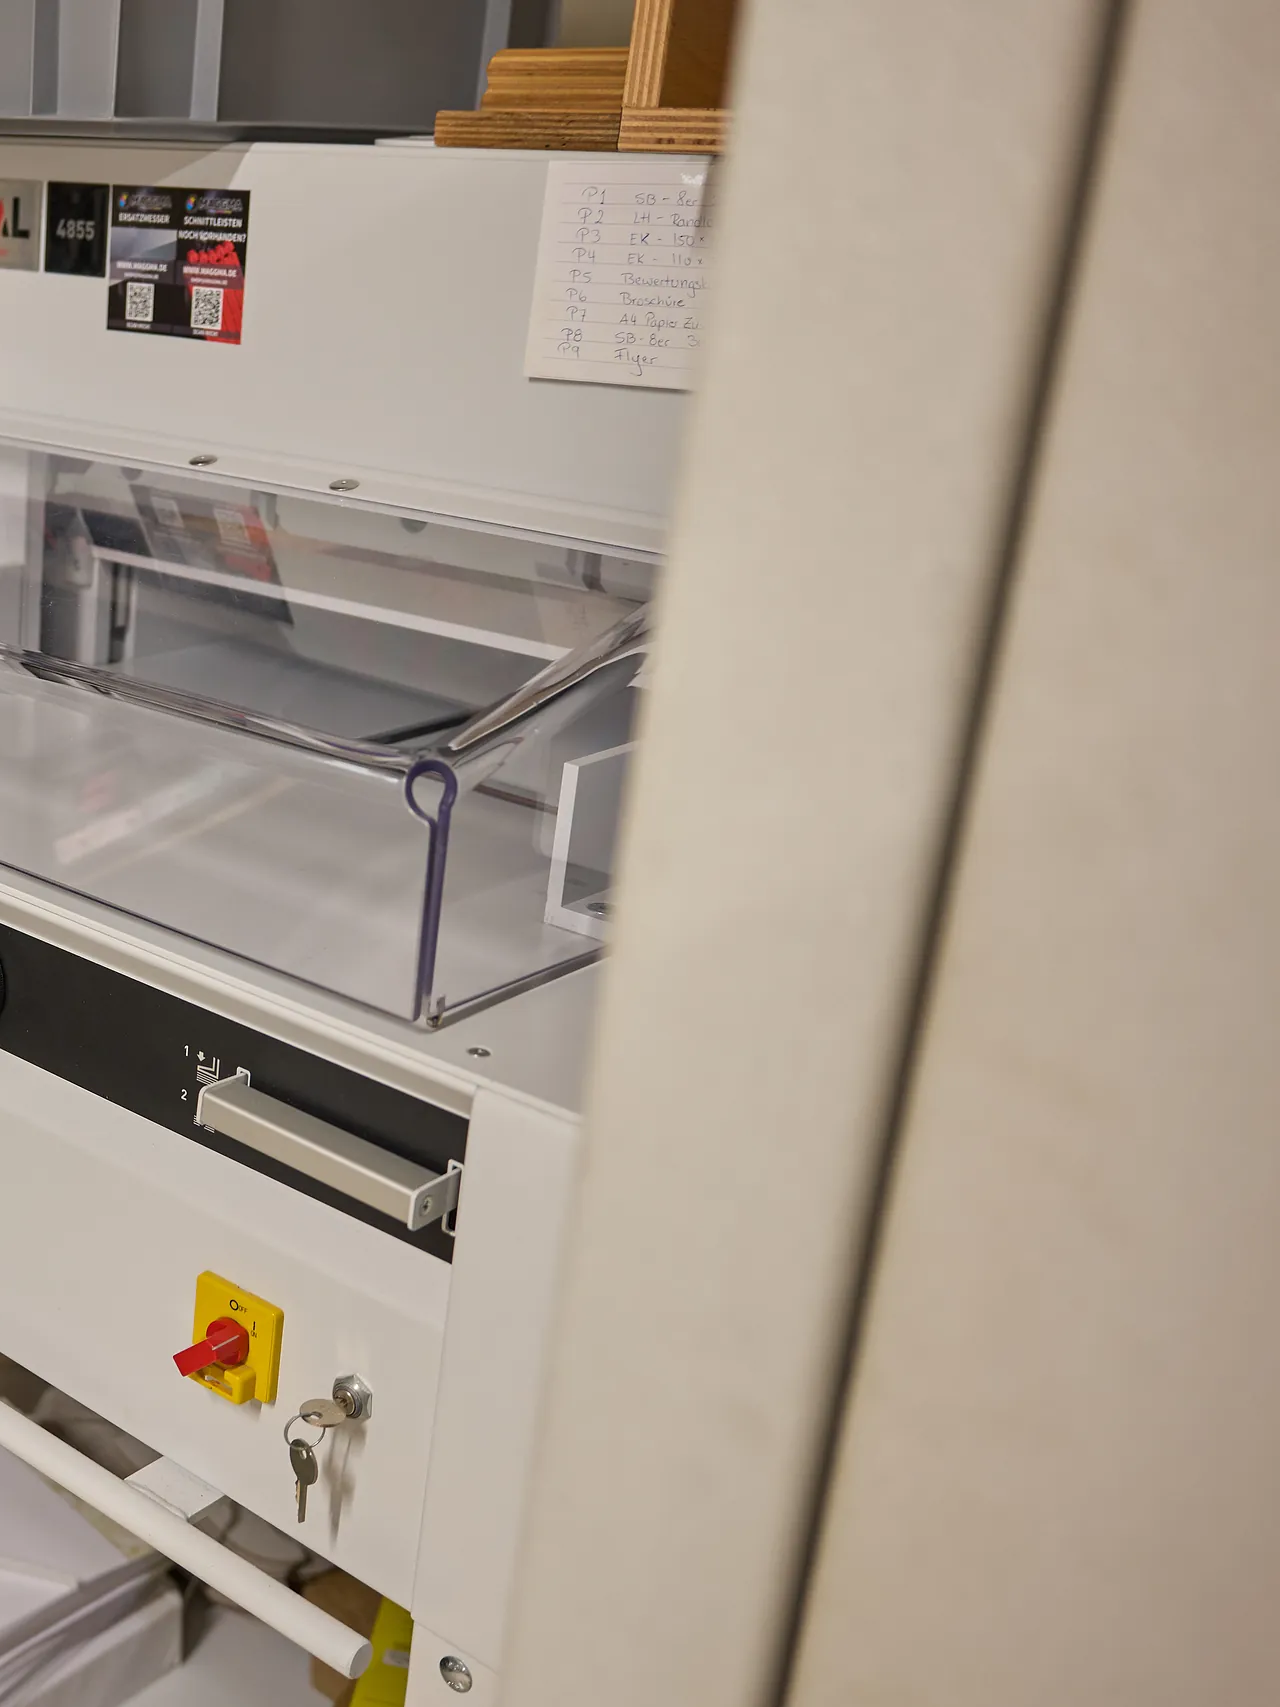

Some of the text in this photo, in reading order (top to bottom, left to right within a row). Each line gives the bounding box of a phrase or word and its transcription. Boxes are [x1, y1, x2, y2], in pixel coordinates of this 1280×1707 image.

[581, 186, 606, 205] P1
[183, 216, 243, 228] SCHNITTLEISTEN
[577, 207, 605, 225] P2
[55, 219, 96, 240] 4855
[576, 227, 601, 244] P3
[630, 233, 650, 246] EK
[572, 247, 595, 264] P4
[627, 253, 644, 265] EK
[570, 269, 592, 284] P5
[566, 287, 587, 302] P6
[566, 305, 587, 323] P7
[561, 327, 583, 343] P8
[557, 341, 580, 359] P9
[184, 1044, 189, 1057] 1
[180, 1088, 188, 1101] 2
